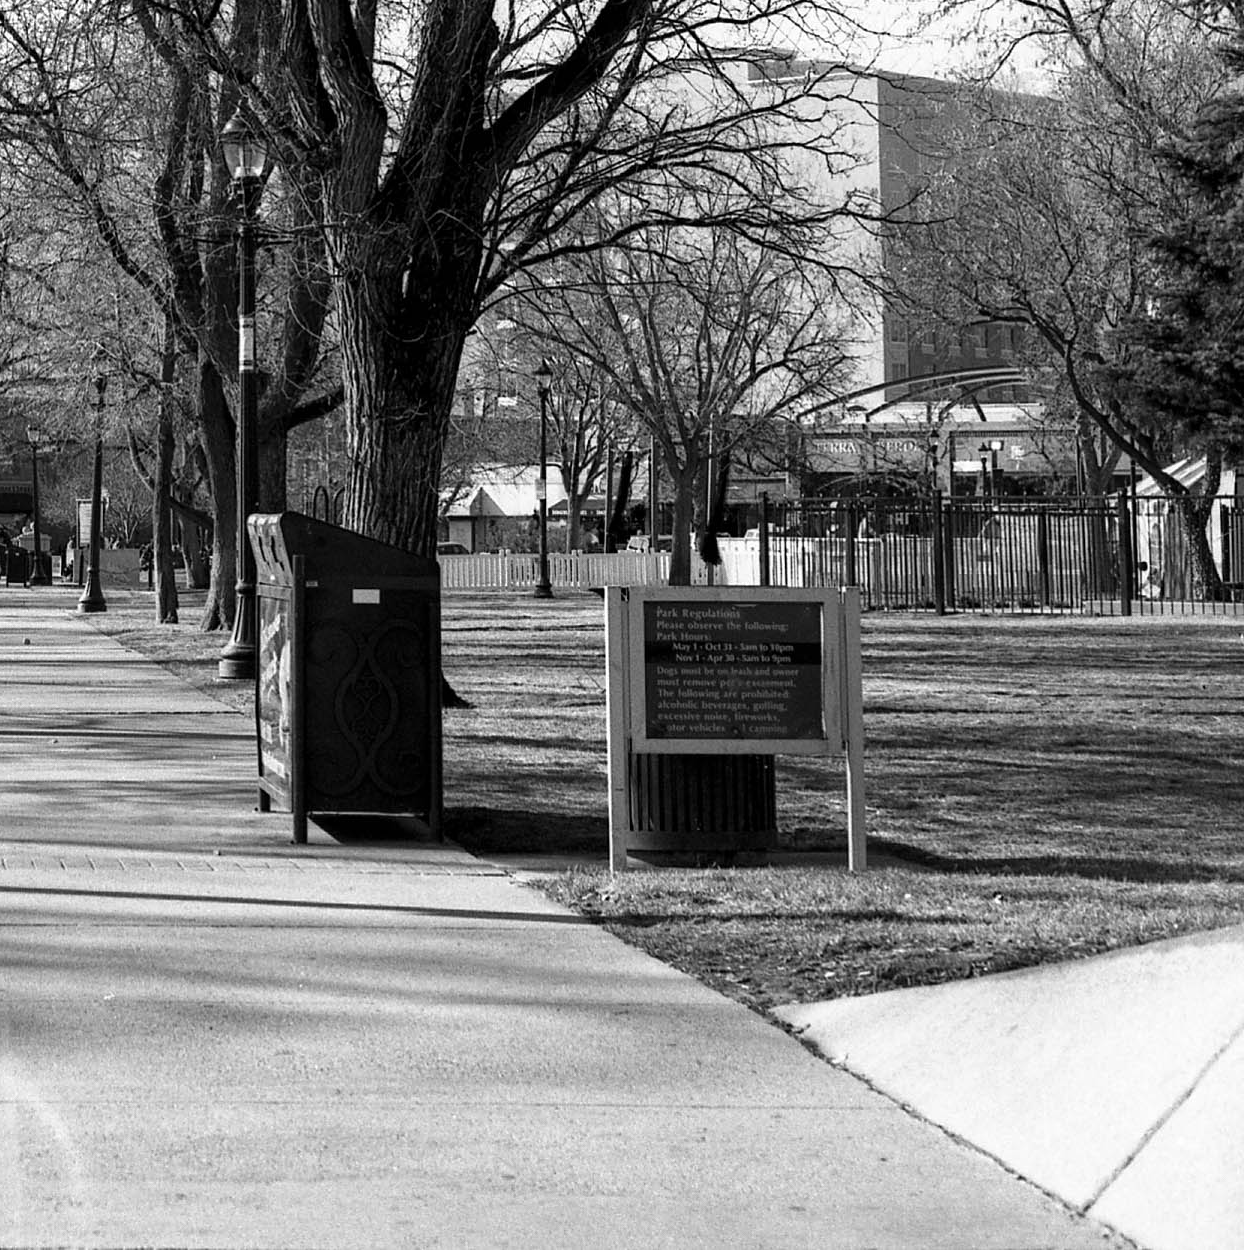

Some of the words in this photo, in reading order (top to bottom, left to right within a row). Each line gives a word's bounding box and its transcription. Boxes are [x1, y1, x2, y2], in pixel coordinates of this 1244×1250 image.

[656, 607, 678, 618] Park
[682, 608, 741, 620] Regulations
[656, 620, 685, 630] Please
[687, 621, 723, 630] observe
[726, 621, 742, 630] the
[745, 621, 789, 633] following:
[656, 632, 677, 641] Park
[672, 642, 690, 652] May
[705, 642, 721, 651] Oct
[723, 642, 732, 651] 31
[759, 643, 768, 651] to
[770, 643, 794, 653] 10pm
[675, 653, 693, 662] Nov
[707, 654, 723, 664] Apr
[725, 654, 735, 662] 30
[741, 654, 759, 662] 5am
[761, 654, 770, 662] to
[772, 654, 791, 664] 9pm
[656, 666, 678, 677] Dogs
[681, 666, 701, 675] must
[704, 666, 714, 675] be
[717, 668, 729, 676] on
[730, 666, 752, 675] leash
[754, 667, 770, 675] and
[772, 668, 799, 676] owner
[656, 678, 679, 686] must
[683, 679, 717, 687] remove
[658, 689, 675, 698] The
[677, 688, 720, 700] following
[723, 690, 738, 698] are
[657, 700, 698, 709] alcoholic
[657, 711, 701, 720] excessive
[660, 723, 686, 732] otor
